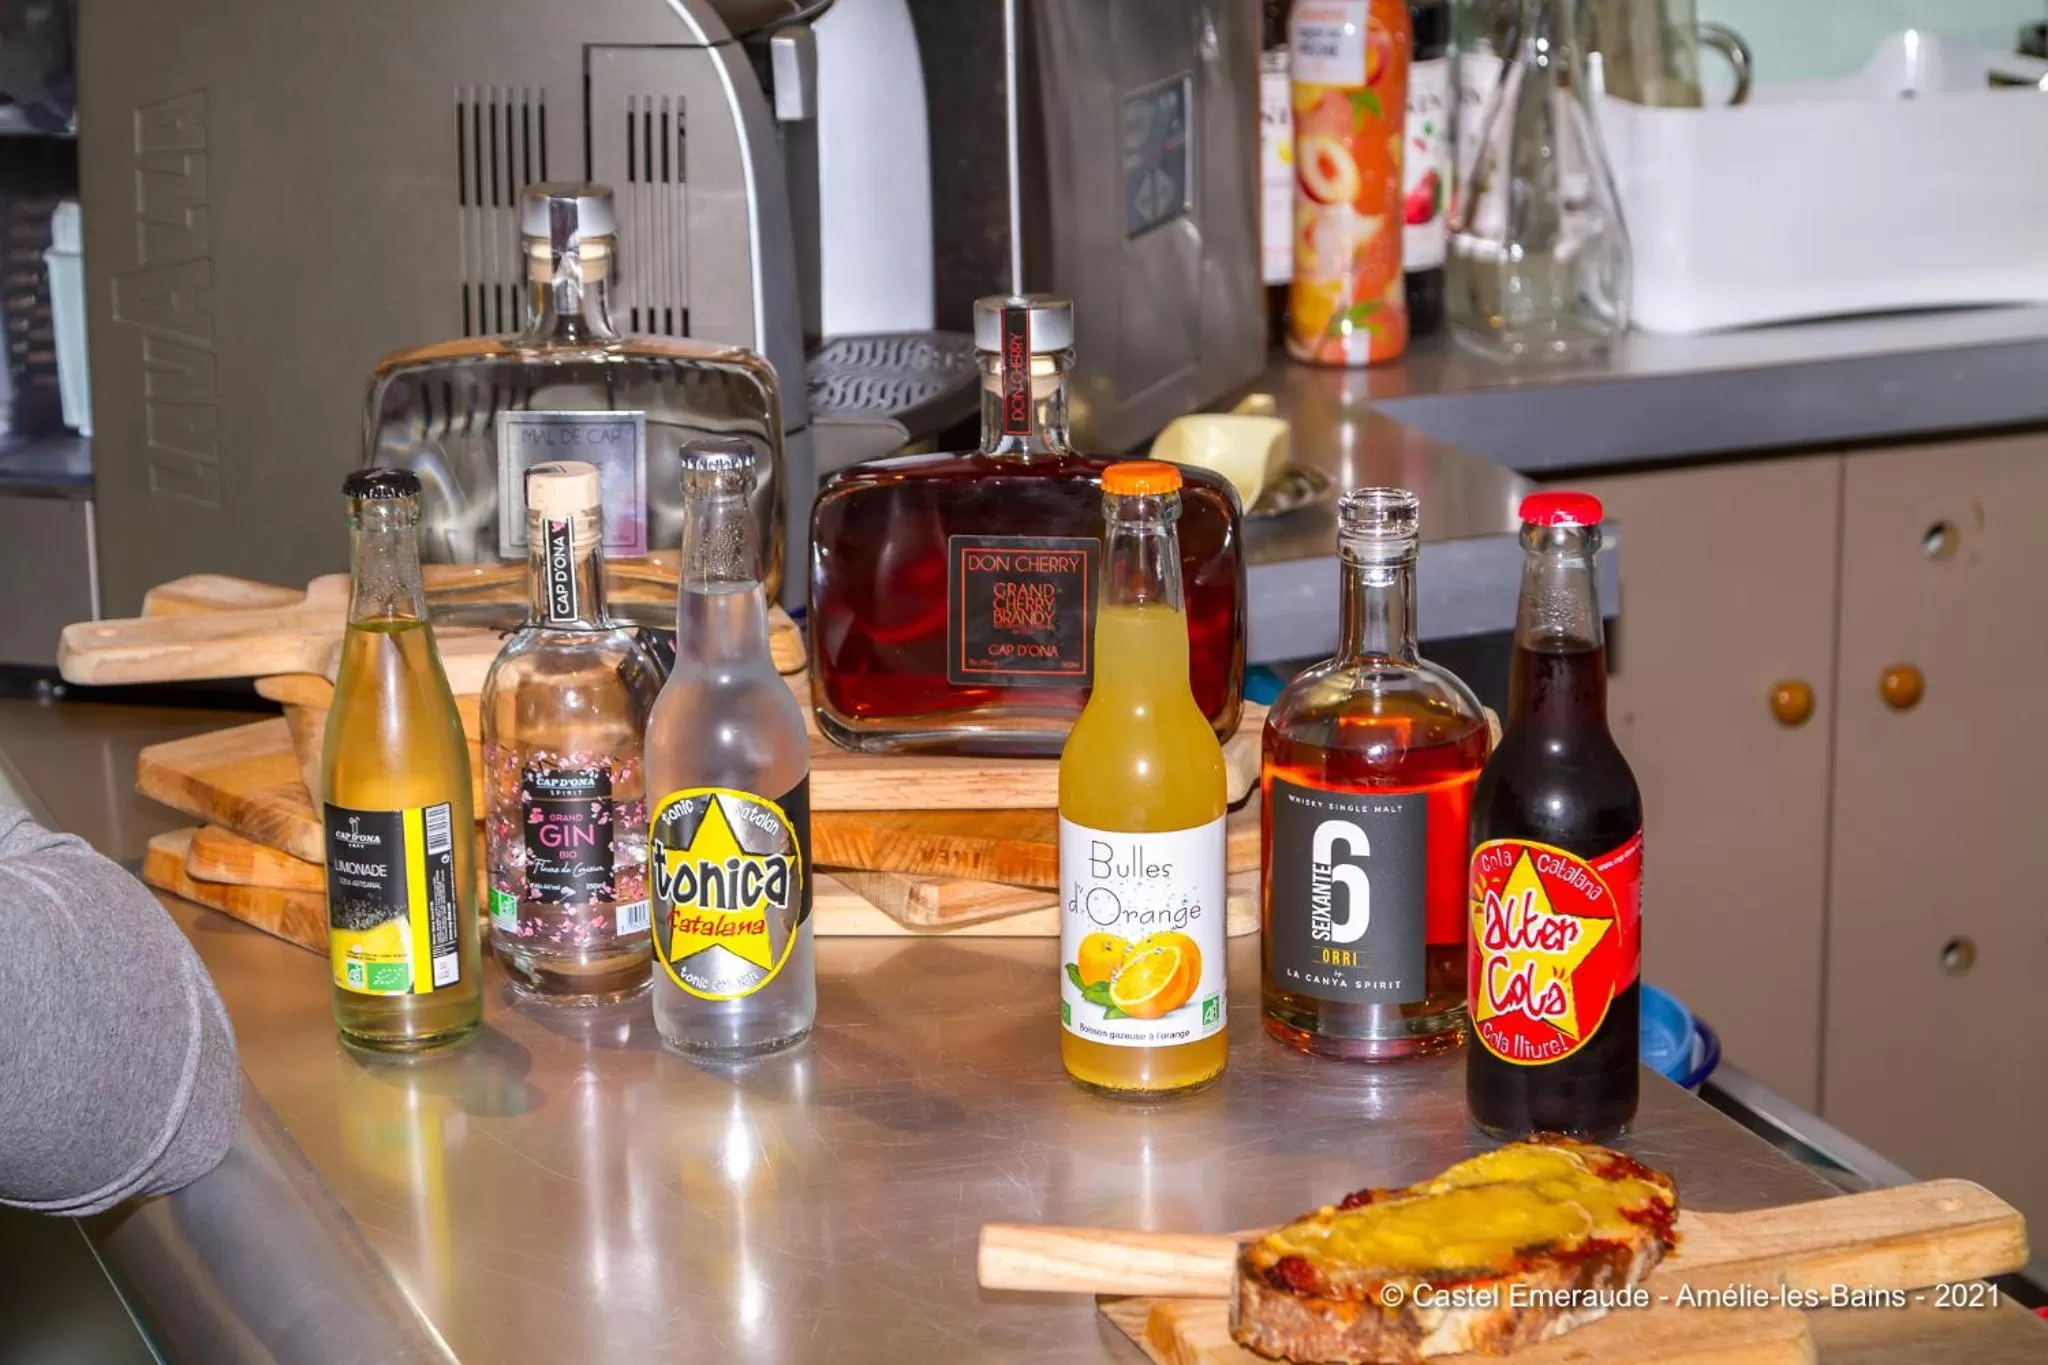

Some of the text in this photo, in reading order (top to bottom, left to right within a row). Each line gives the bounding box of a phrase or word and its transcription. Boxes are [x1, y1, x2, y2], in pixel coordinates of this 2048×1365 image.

[559, 428, 581, 446] DE
[586, 427, 622, 446] CAP
[968, 554, 1079, 574] DON CHERRY
[553, 536, 570, 614] CAP D'ONA
[993, 582, 1055, 598] GRAND
[993, 597, 1056, 611] CHERRY
[993, 609, 1056, 626] BRANDY
[988, 644, 1059, 657] CAP D'ONA
[661, 799, 694, 826] tonic
[1288, 794, 1403, 813] WHISKY SINGLE MALT
[549, 813, 584, 822] GRAND
[539, 824, 595, 848] GIN
[559, 850, 577, 859] BIO
[1089, 840, 1173, 879] Bulles
[334, 859, 388, 877] LIMONADE
[653, 839, 791, 912] tonica
[1480, 848, 1513, 872] Cola
[1536, 854, 1604, 901] Catalana
[1312, 819, 1371, 943] 6
[1068, 882, 1202, 929] d'Orange
[1311, 863, 1332, 941] SEIXANTE
[668, 911, 766, 937] Catalana
[1322, 948, 1358, 967] ORRI
[1286, 967, 1401, 989] LA CANYA SPIRIT
[1079, 1022, 1108, 1038] Boisson
[1109, 1032, 1147, 1041] gazeuse
[1156, 1029, 1191, 1041] l'orange
[1482, 1022, 1569, 1060] Cola lliure!
